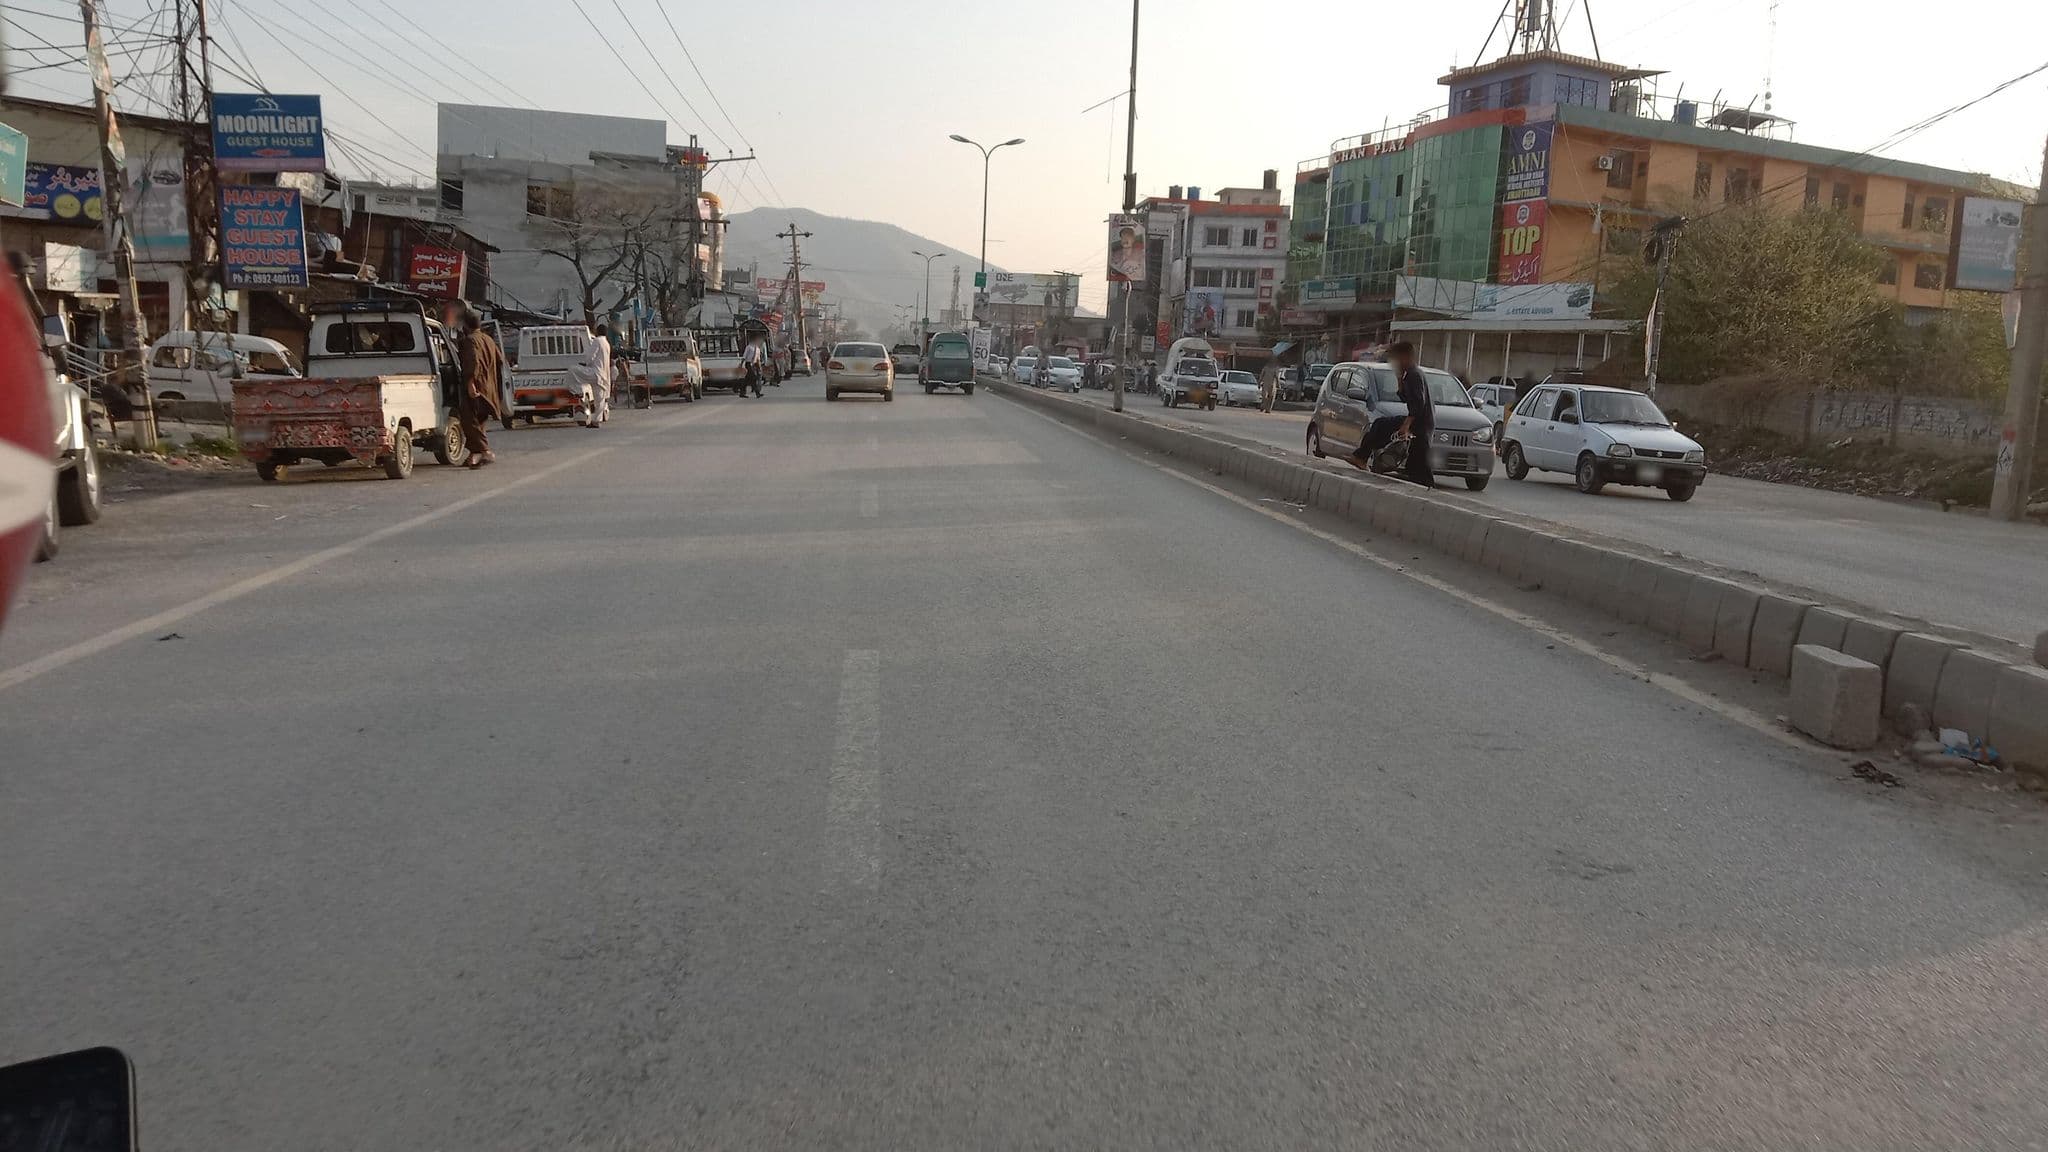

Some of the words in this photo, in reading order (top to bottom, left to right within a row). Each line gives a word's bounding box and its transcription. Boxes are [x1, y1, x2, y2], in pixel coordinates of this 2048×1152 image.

[217, 115, 319, 134] MOONLIGHT
[227, 136, 268, 147] GUEST
[271, 136, 314, 147] HOUSE
[1508, 150, 1546, 174] AMNI
[223, 188, 296, 207] HAPPY
[234, 209, 288, 226] STAY
[227, 228, 298, 245] GUEST
[1502, 225, 1541, 256] TOP
[227, 247, 302, 265] HOUSE
[417, 264, 452, 277] کراچی
[514, 378, 565, 387] SUZUKI
